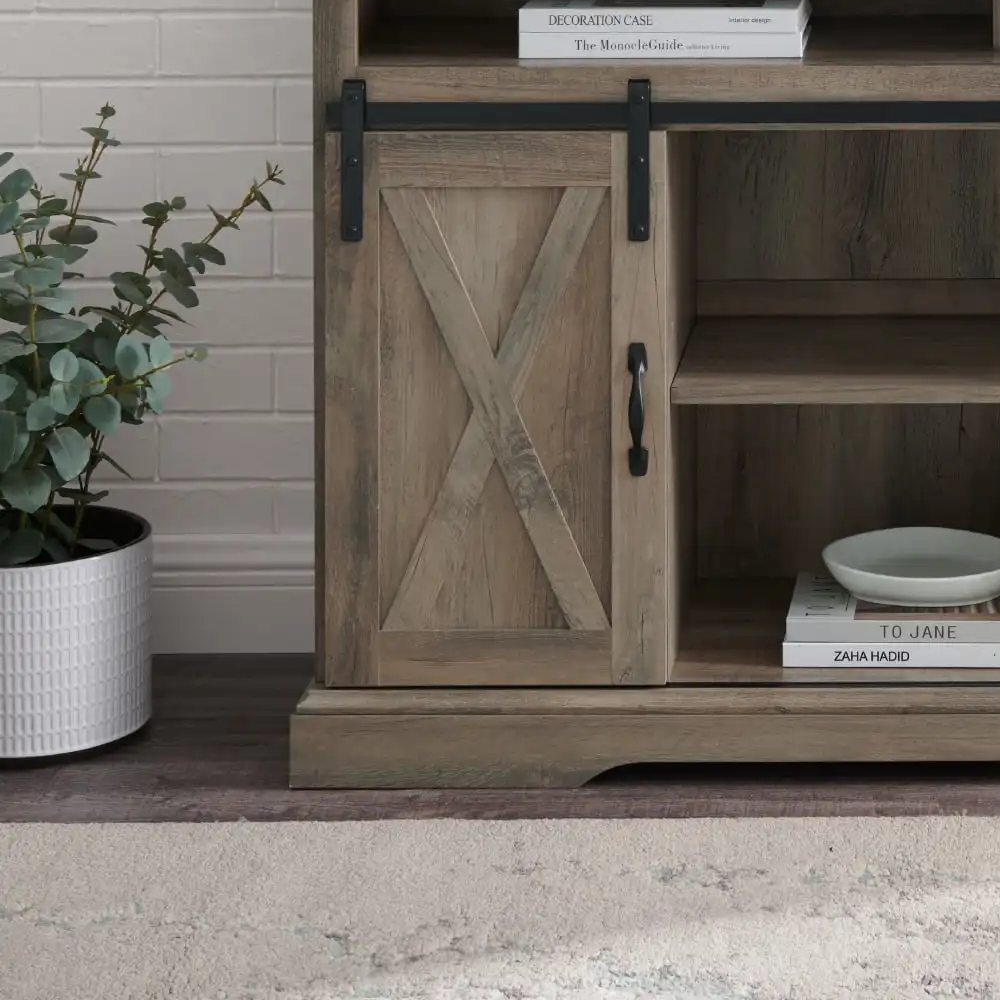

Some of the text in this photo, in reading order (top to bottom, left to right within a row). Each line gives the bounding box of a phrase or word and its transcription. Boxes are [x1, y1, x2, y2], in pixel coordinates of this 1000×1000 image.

[548, 14, 654, 26] DECORATION CASE
[574, 39, 597, 51] The
[880, 625, 957, 639] TO JANE
[833, 651, 910, 662] ZAHA HADID
